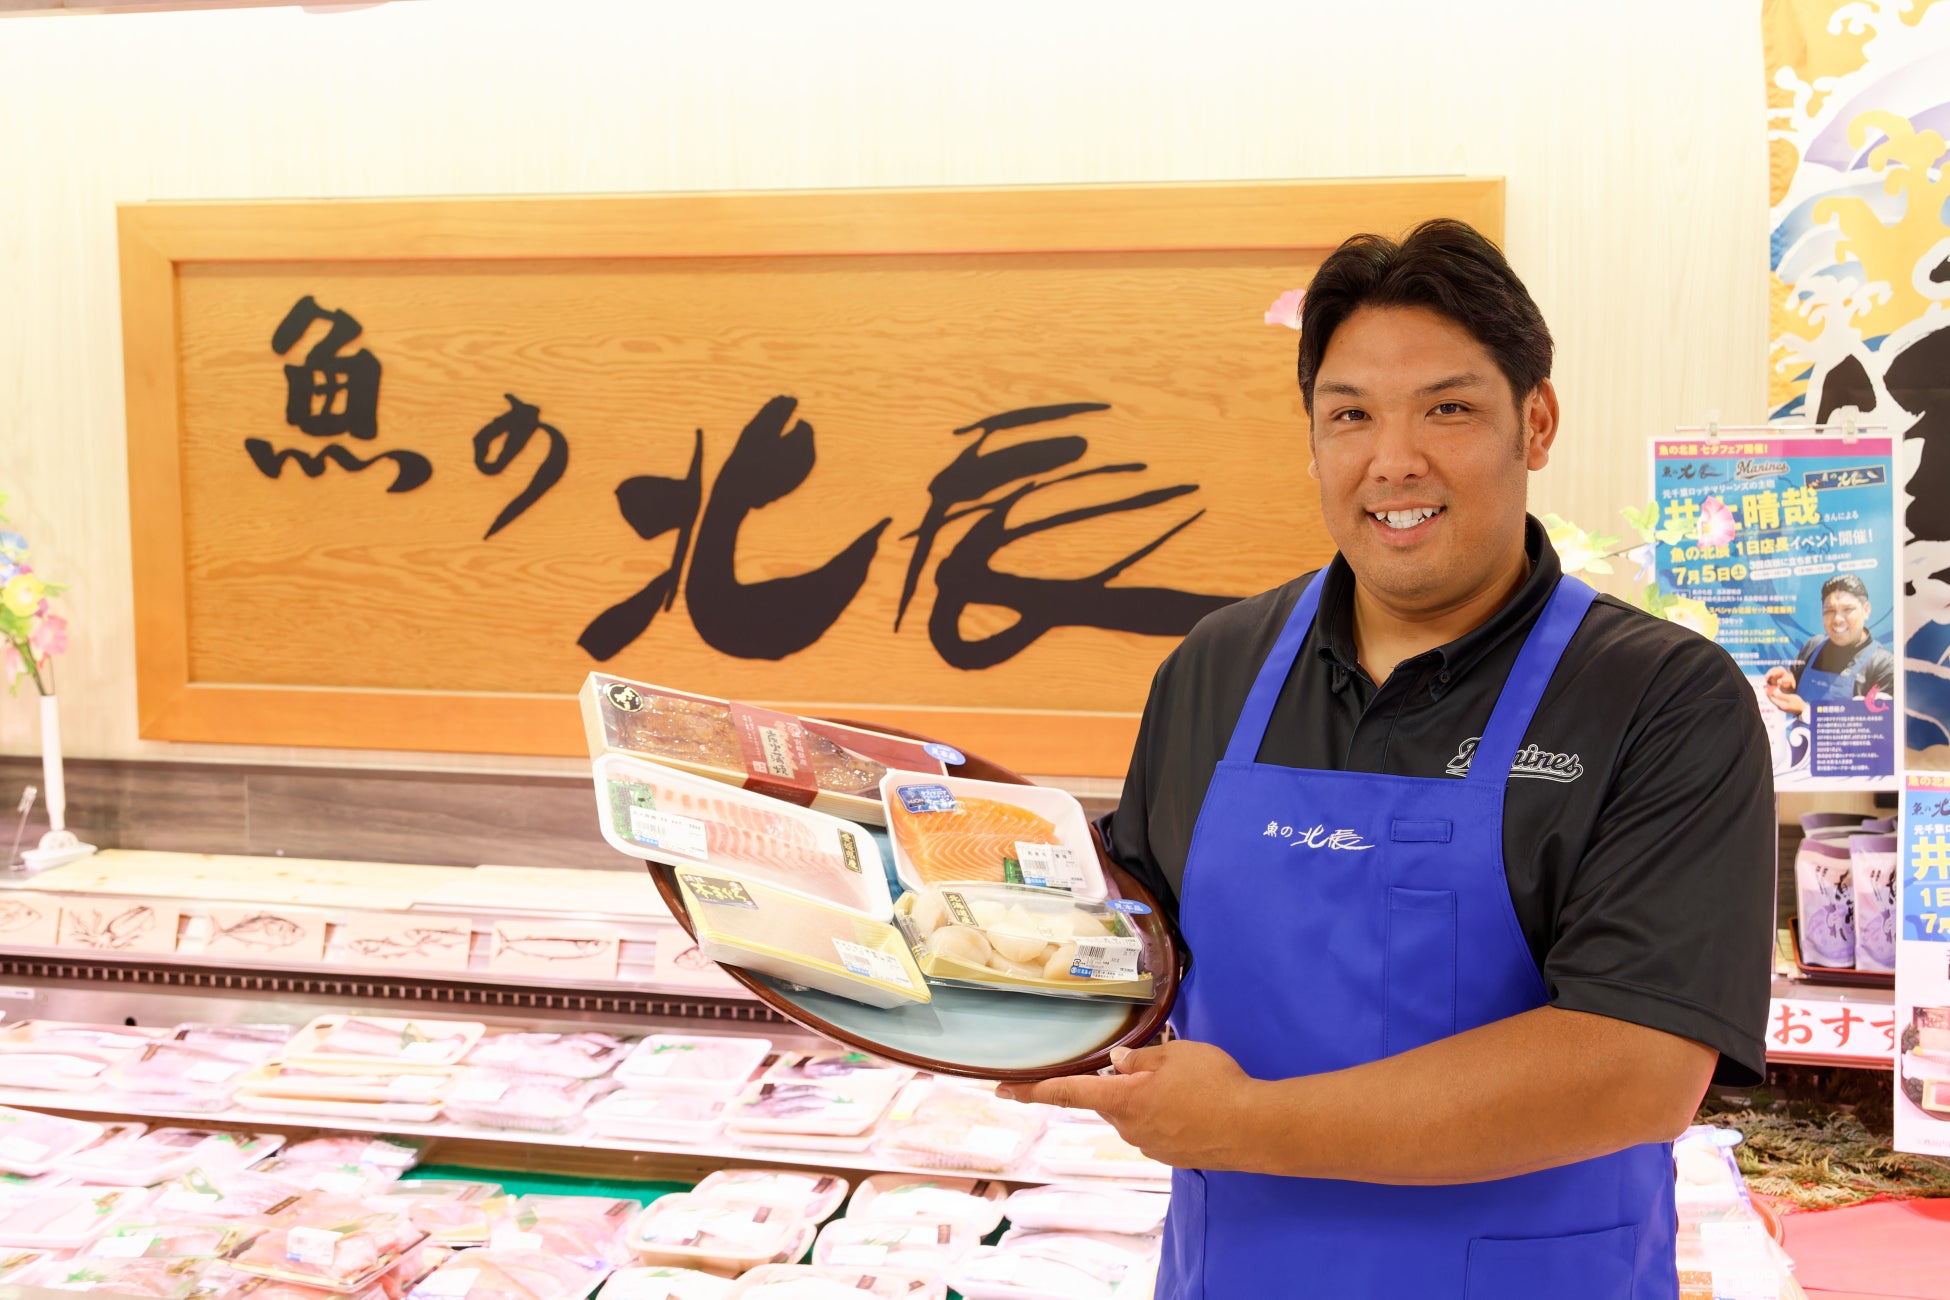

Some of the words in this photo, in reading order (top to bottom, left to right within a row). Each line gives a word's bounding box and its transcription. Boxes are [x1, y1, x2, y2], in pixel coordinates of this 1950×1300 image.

[1659, 444, 1698, 456] 魚の北辰
[245, 296, 1245, 670] 魚の北辰
[1262, 820, 1375, 850] 魚の北辰
